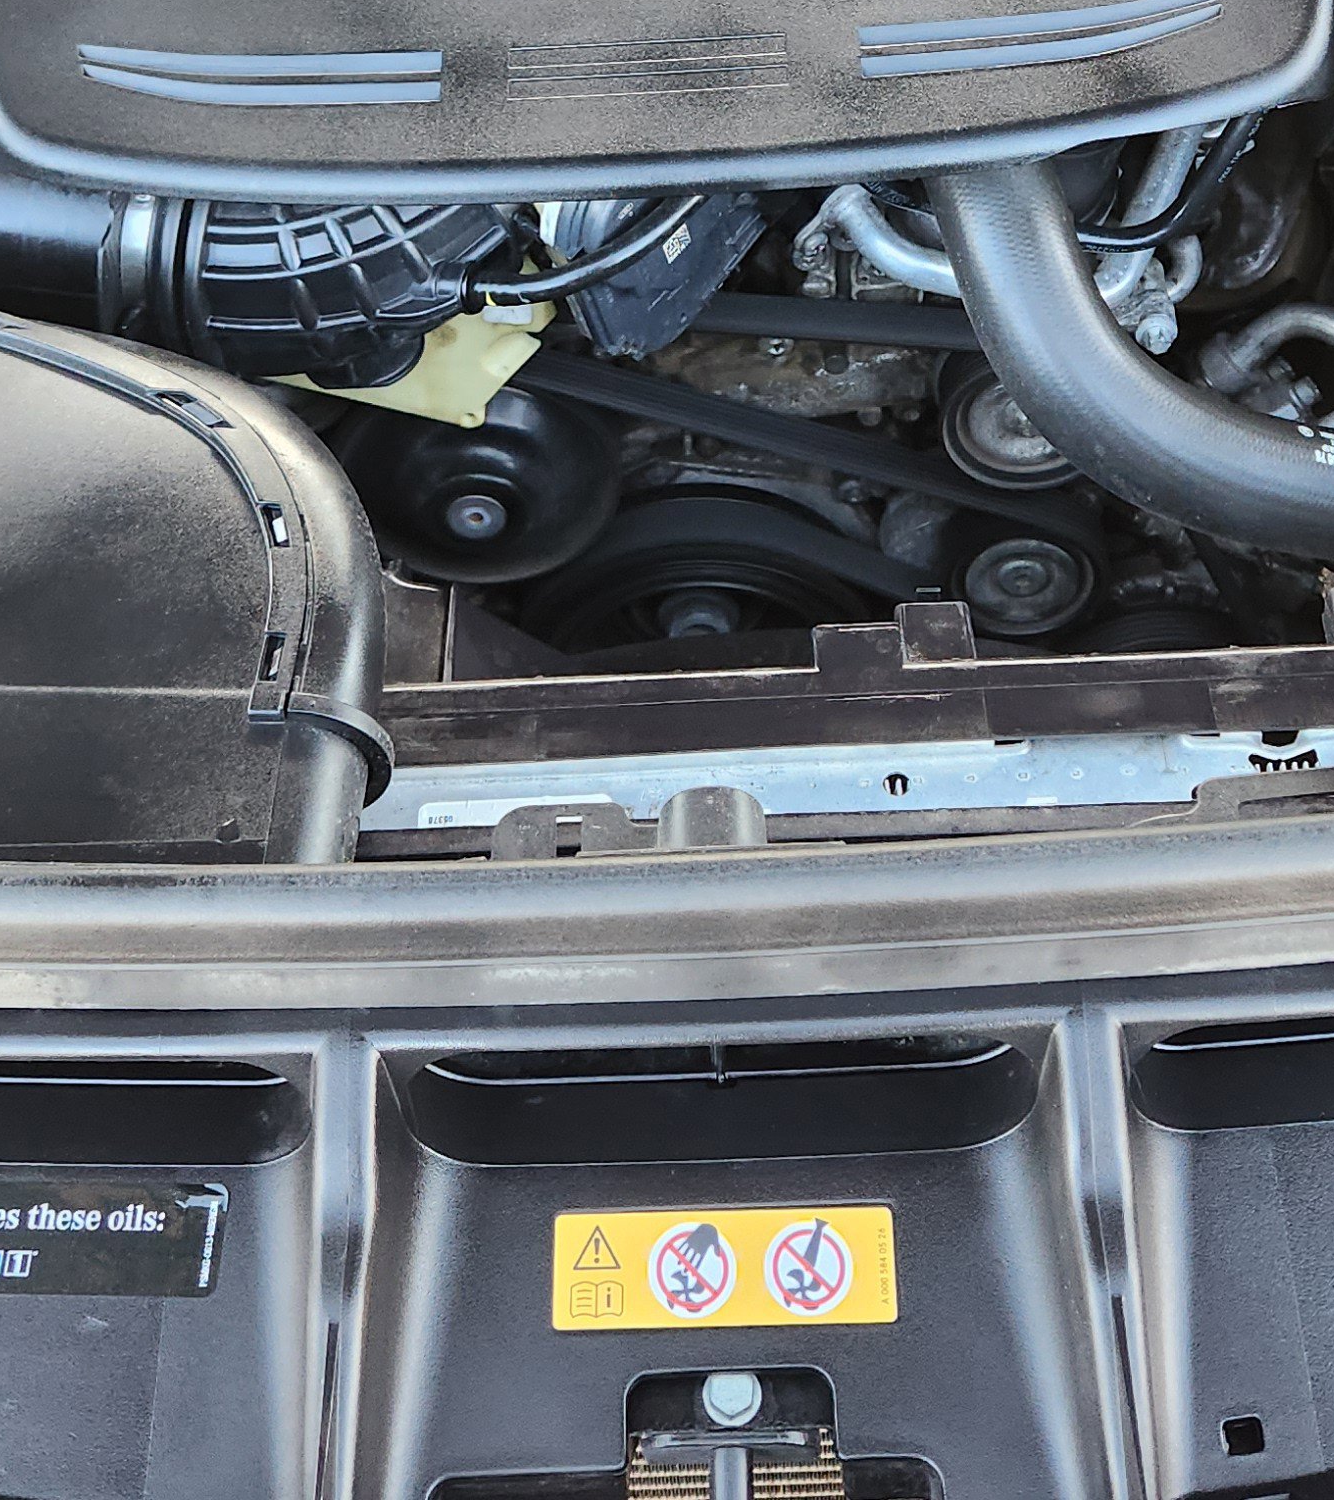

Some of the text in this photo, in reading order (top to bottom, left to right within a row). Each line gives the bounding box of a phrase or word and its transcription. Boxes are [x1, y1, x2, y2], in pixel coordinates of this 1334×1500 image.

[27, 1202, 101, 1232] these
[107, 1203, 167, 1233] oils:
[878, 1242, 886, 1253] 05
[879, 1257, 888, 1274] 584
[879, 1276, 889, 1294] 000
